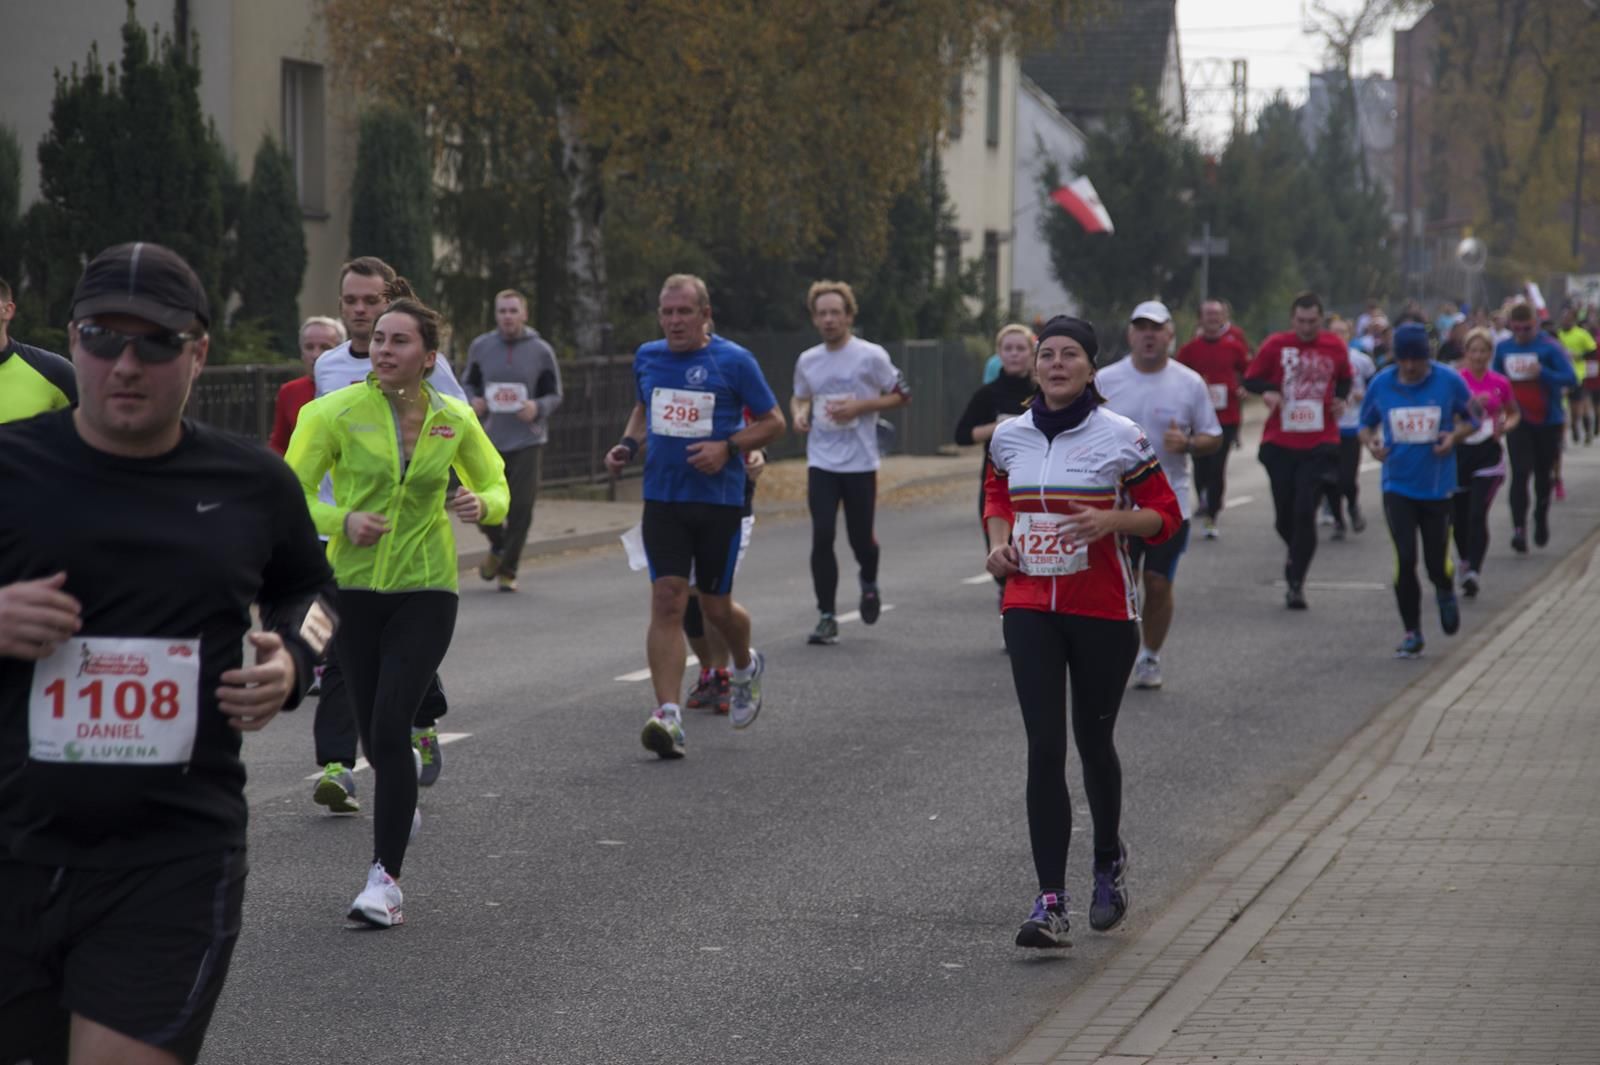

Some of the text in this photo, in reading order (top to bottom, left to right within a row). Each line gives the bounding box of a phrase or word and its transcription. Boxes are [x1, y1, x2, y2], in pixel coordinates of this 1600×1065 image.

[663, 405, 699, 422] 298
[44, 678, 180, 721] 1108
[76, 723, 145, 740] DANIEL
[90, 745, 160, 759] LUVENA
